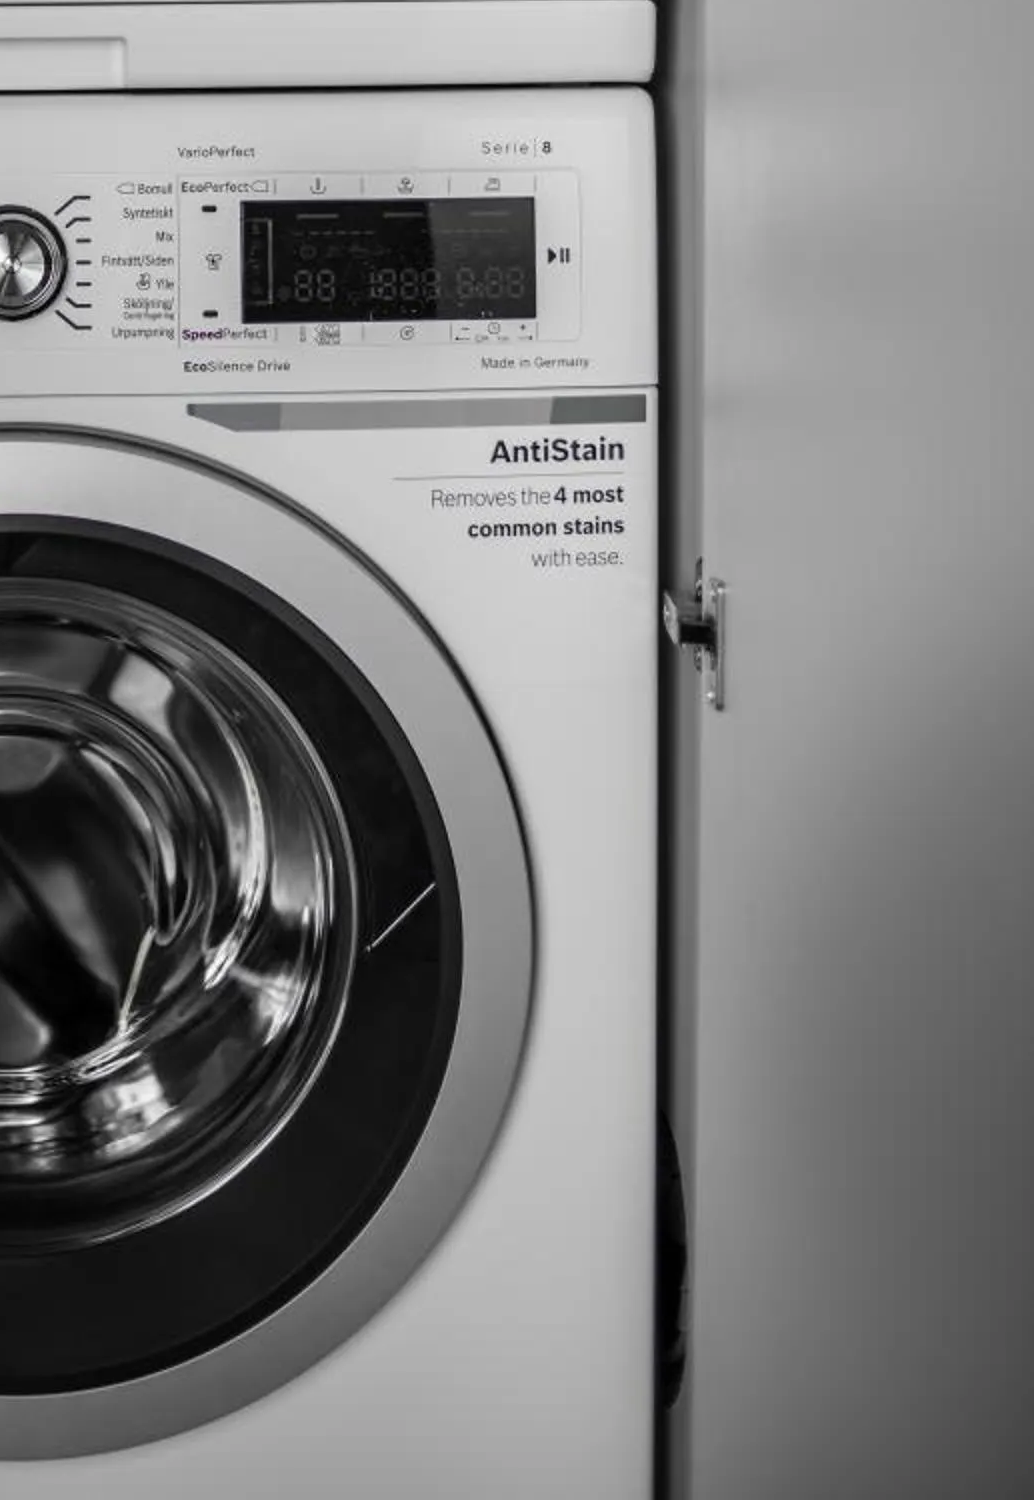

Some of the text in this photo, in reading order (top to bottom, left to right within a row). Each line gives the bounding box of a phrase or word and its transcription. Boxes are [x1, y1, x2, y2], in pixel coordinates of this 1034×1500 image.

[177, 145, 256, 158] VarioPerfect
[481, 140, 552, 154] Serie 8
[181, 181, 250, 193] EcoPerfect
[181, 328, 267, 341] SpeedPerfect
[183, 359, 291, 373] EcoSilence Drive
[481, 355, 589, 370] Made in Germany
[490, 436, 625, 464] AntiStain
[430, 486, 625, 509] Removes the 4 most
[467, 516, 625, 538] common stains
[531, 550, 624, 568] with ease.
